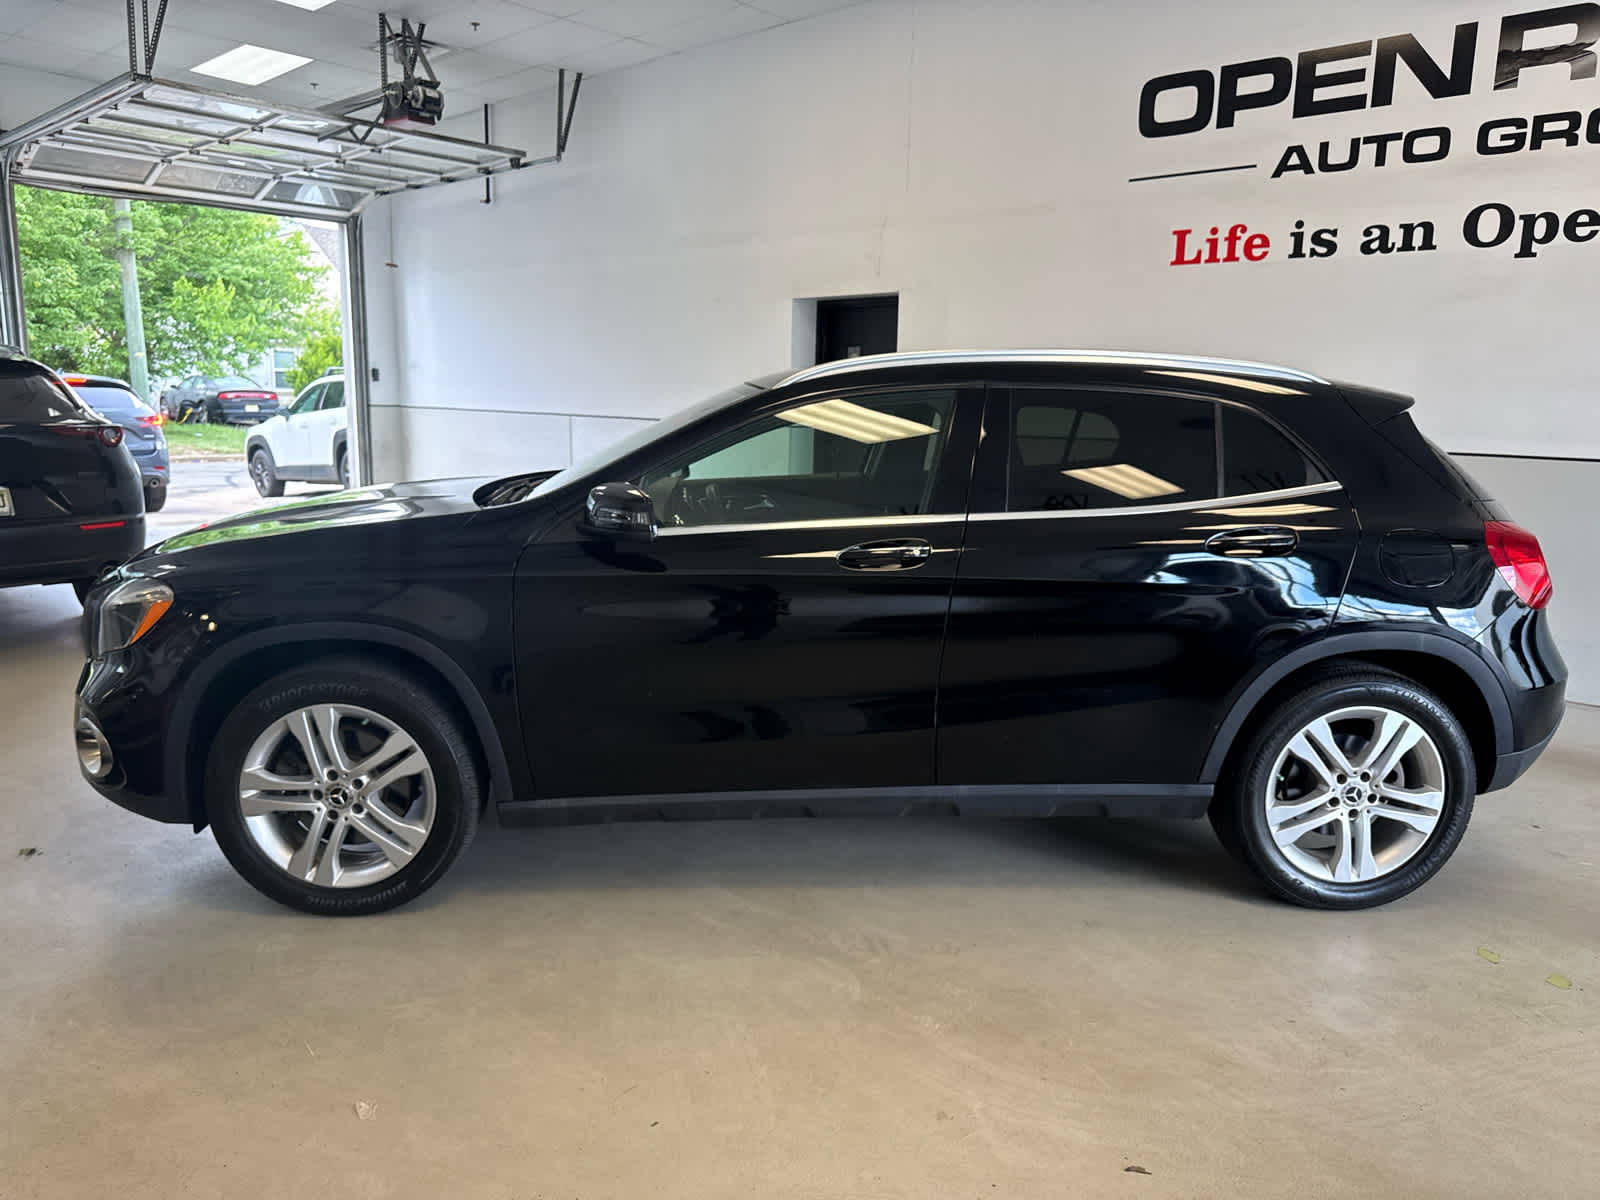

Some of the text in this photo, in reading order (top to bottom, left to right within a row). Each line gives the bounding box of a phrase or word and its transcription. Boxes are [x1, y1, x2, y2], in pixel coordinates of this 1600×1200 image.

[1139, 22, 1478, 138] OPEN
[1271, 127, 1451, 179] AUTO
[1170, 224, 1270, 266] Life
[1288, 220, 1338, 258] is
[1360, 221, 1437, 255] an
